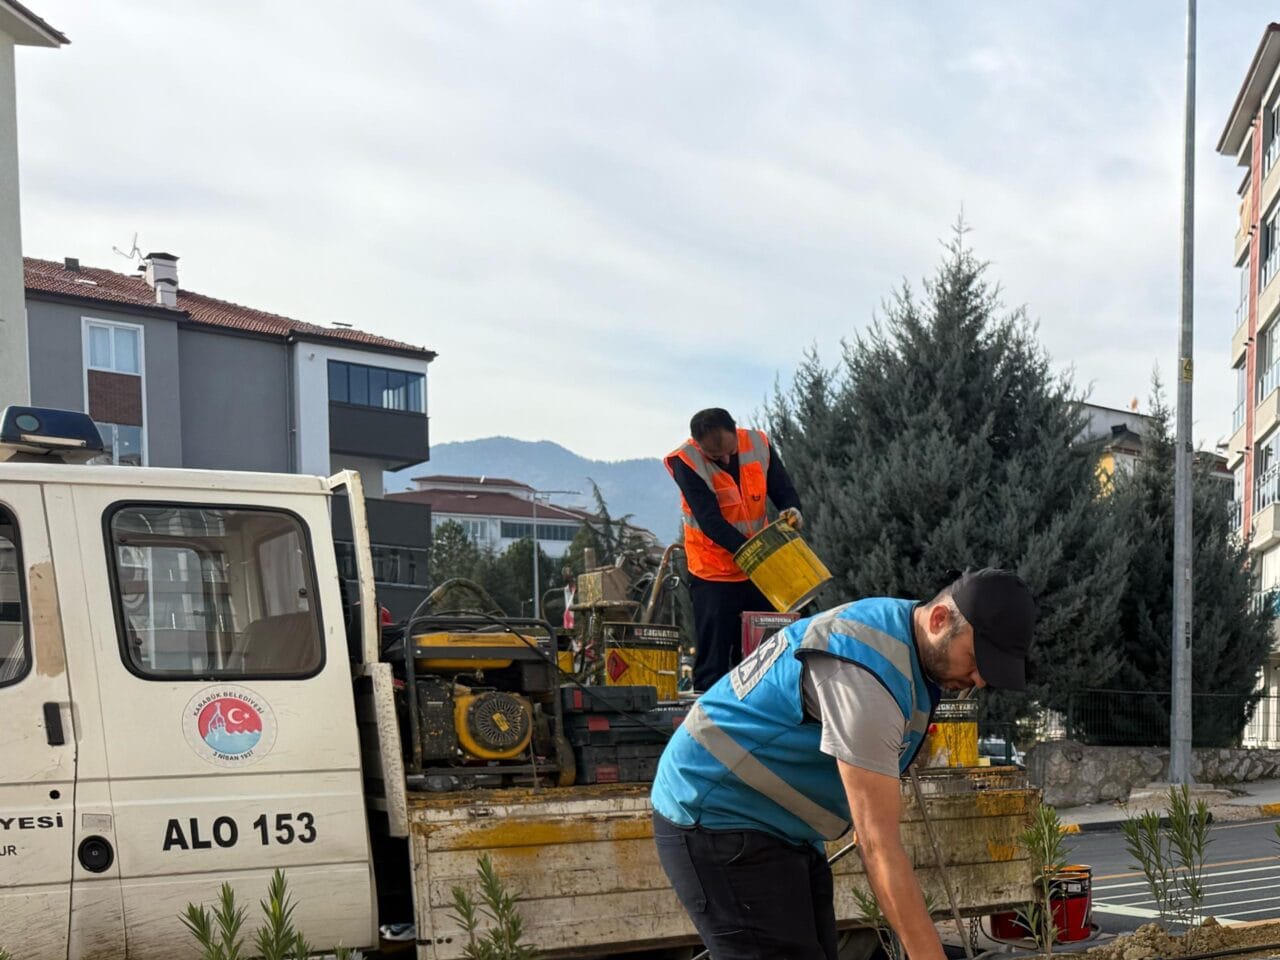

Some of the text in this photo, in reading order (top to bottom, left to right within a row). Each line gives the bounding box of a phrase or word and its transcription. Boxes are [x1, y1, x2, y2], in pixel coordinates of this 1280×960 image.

[193, 691, 264, 716] KARABÜK BELEDİYESİ
[162, 812, 317, 851] ALO 153
